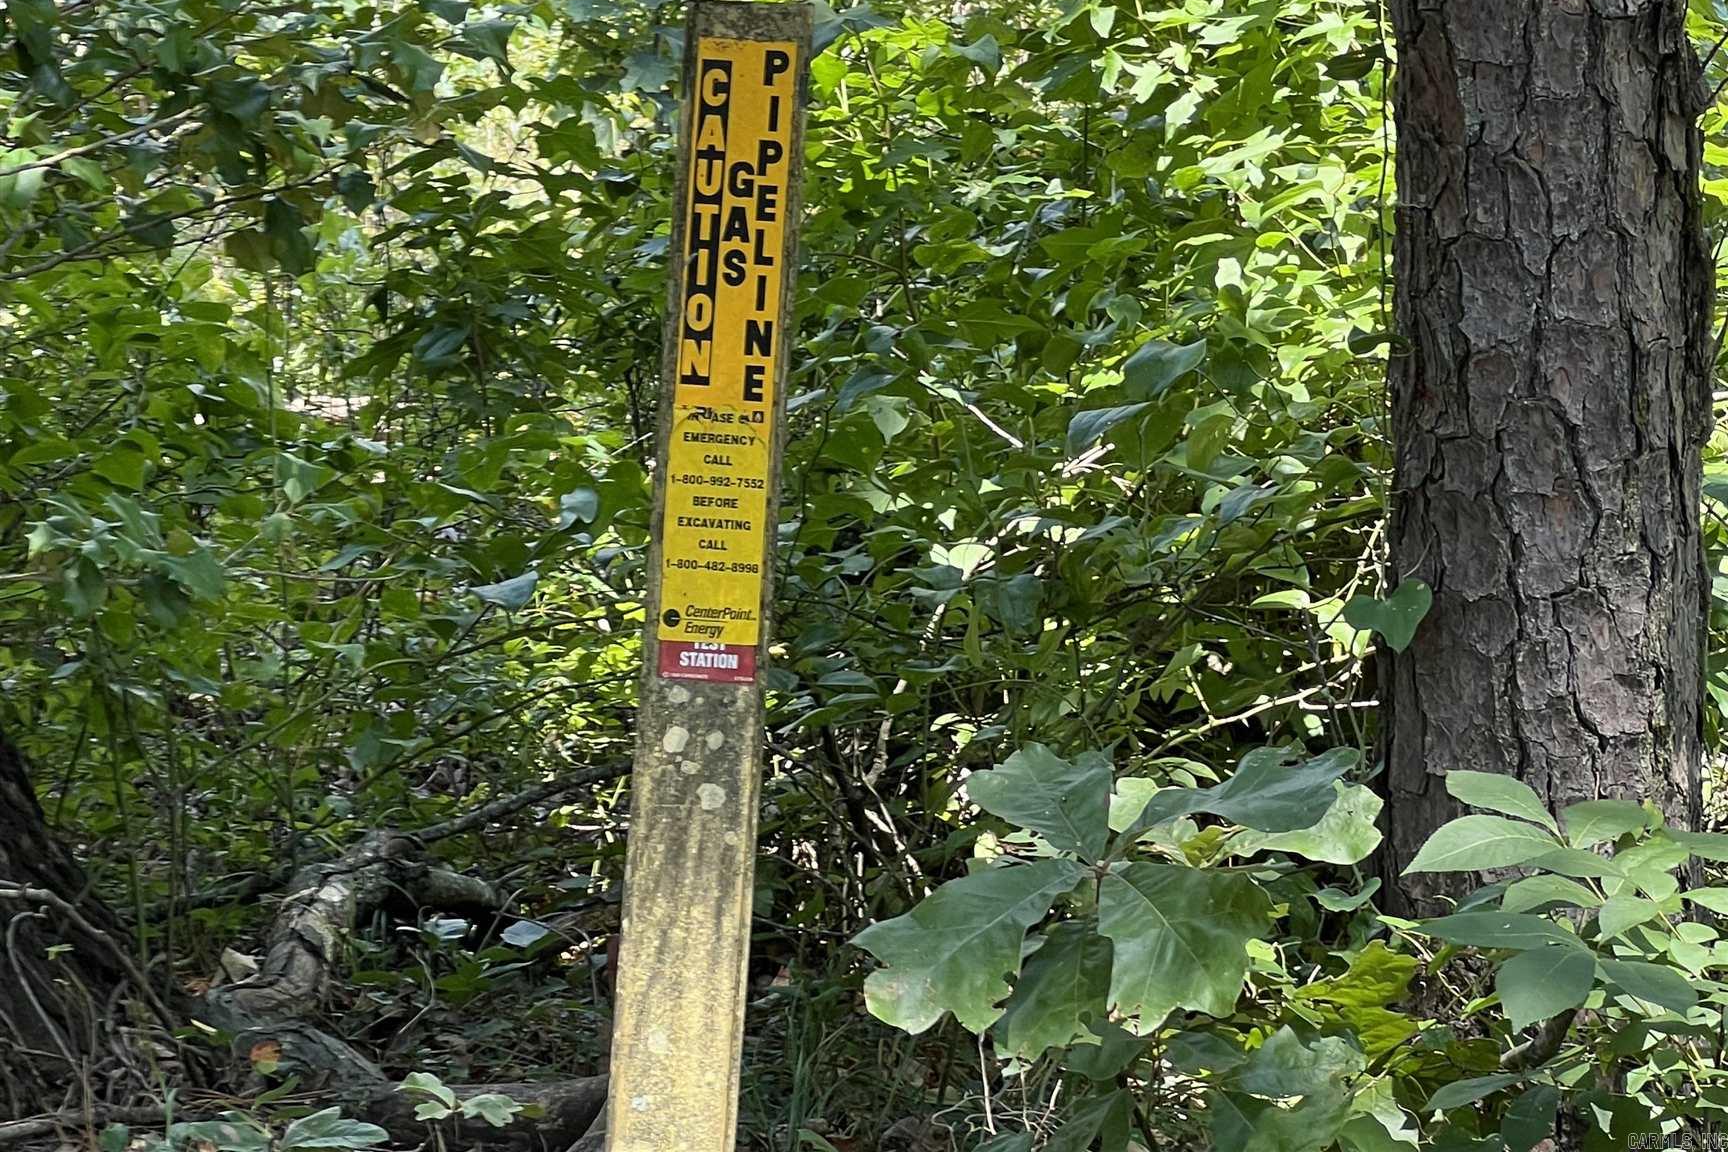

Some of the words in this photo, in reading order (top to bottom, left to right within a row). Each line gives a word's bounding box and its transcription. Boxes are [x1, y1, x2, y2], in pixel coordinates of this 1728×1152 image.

[681, 67, 728, 377] CAUTION
[722, 161, 755, 287] GAS
[743, 50, 790, 402] PIPELINE
[683, 431, 756, 446] EMERGENCY
[703, 454, 733, 466] CALL
[671, 473, 765, 489] 1-800-992-7552
[692, 496, 739, 509] BEFORE
[677, 516, 752, 531] EXCAVATING
[698, 539, 727, 551] CALL
[665, 558, 759, 574] 1-800-482-8998
[685, 604, 752, 621] CenterPoint
[684, 621, 724, 639] Energy
[679, 651, 739, 669] STATION
